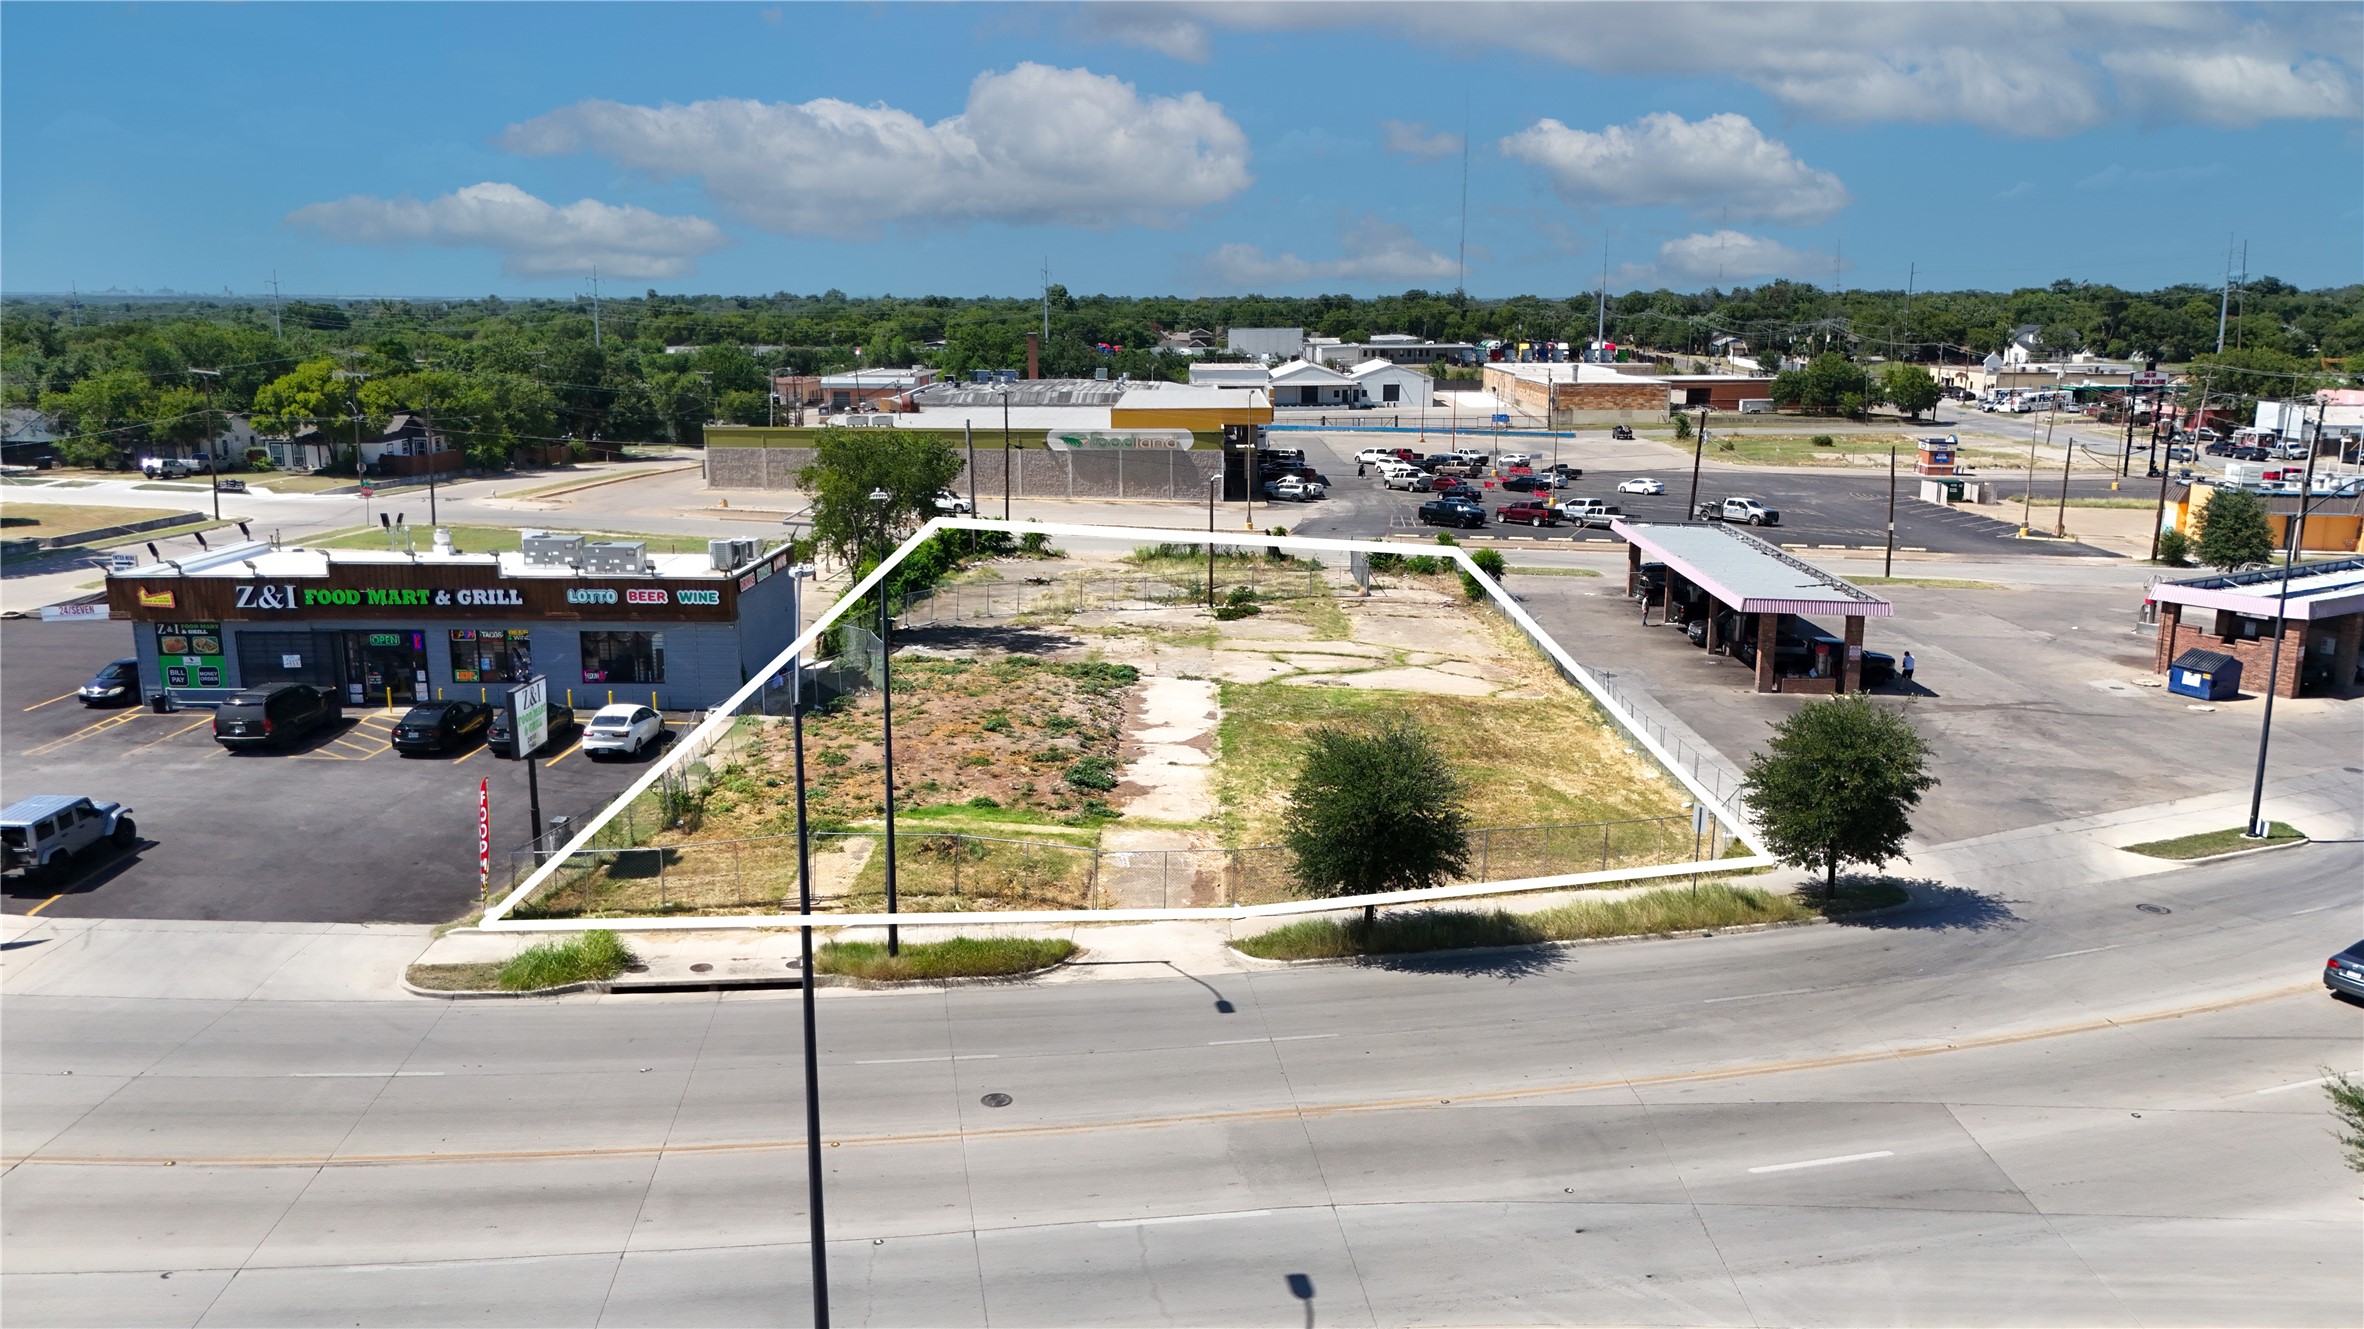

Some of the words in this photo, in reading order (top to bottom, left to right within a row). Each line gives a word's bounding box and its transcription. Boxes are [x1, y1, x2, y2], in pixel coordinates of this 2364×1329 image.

[235, 585, 298, 609] Z&I
[304, 590, 361, 605] FOOD
[367, 590, 430, 605] MART
[435, 590, 450, 605] &
[456, 590, 523, 605] GRILL
[567, 588, 619, 604] LOTTO
[626, 589, 669, 604] BEER
[677, 590, 720, 605] WINE
[58, 605, 95, 615] 24/SEVEN
[371, 635, 398, 644] OPEN
[522, 683, 541, 710] Z&I
